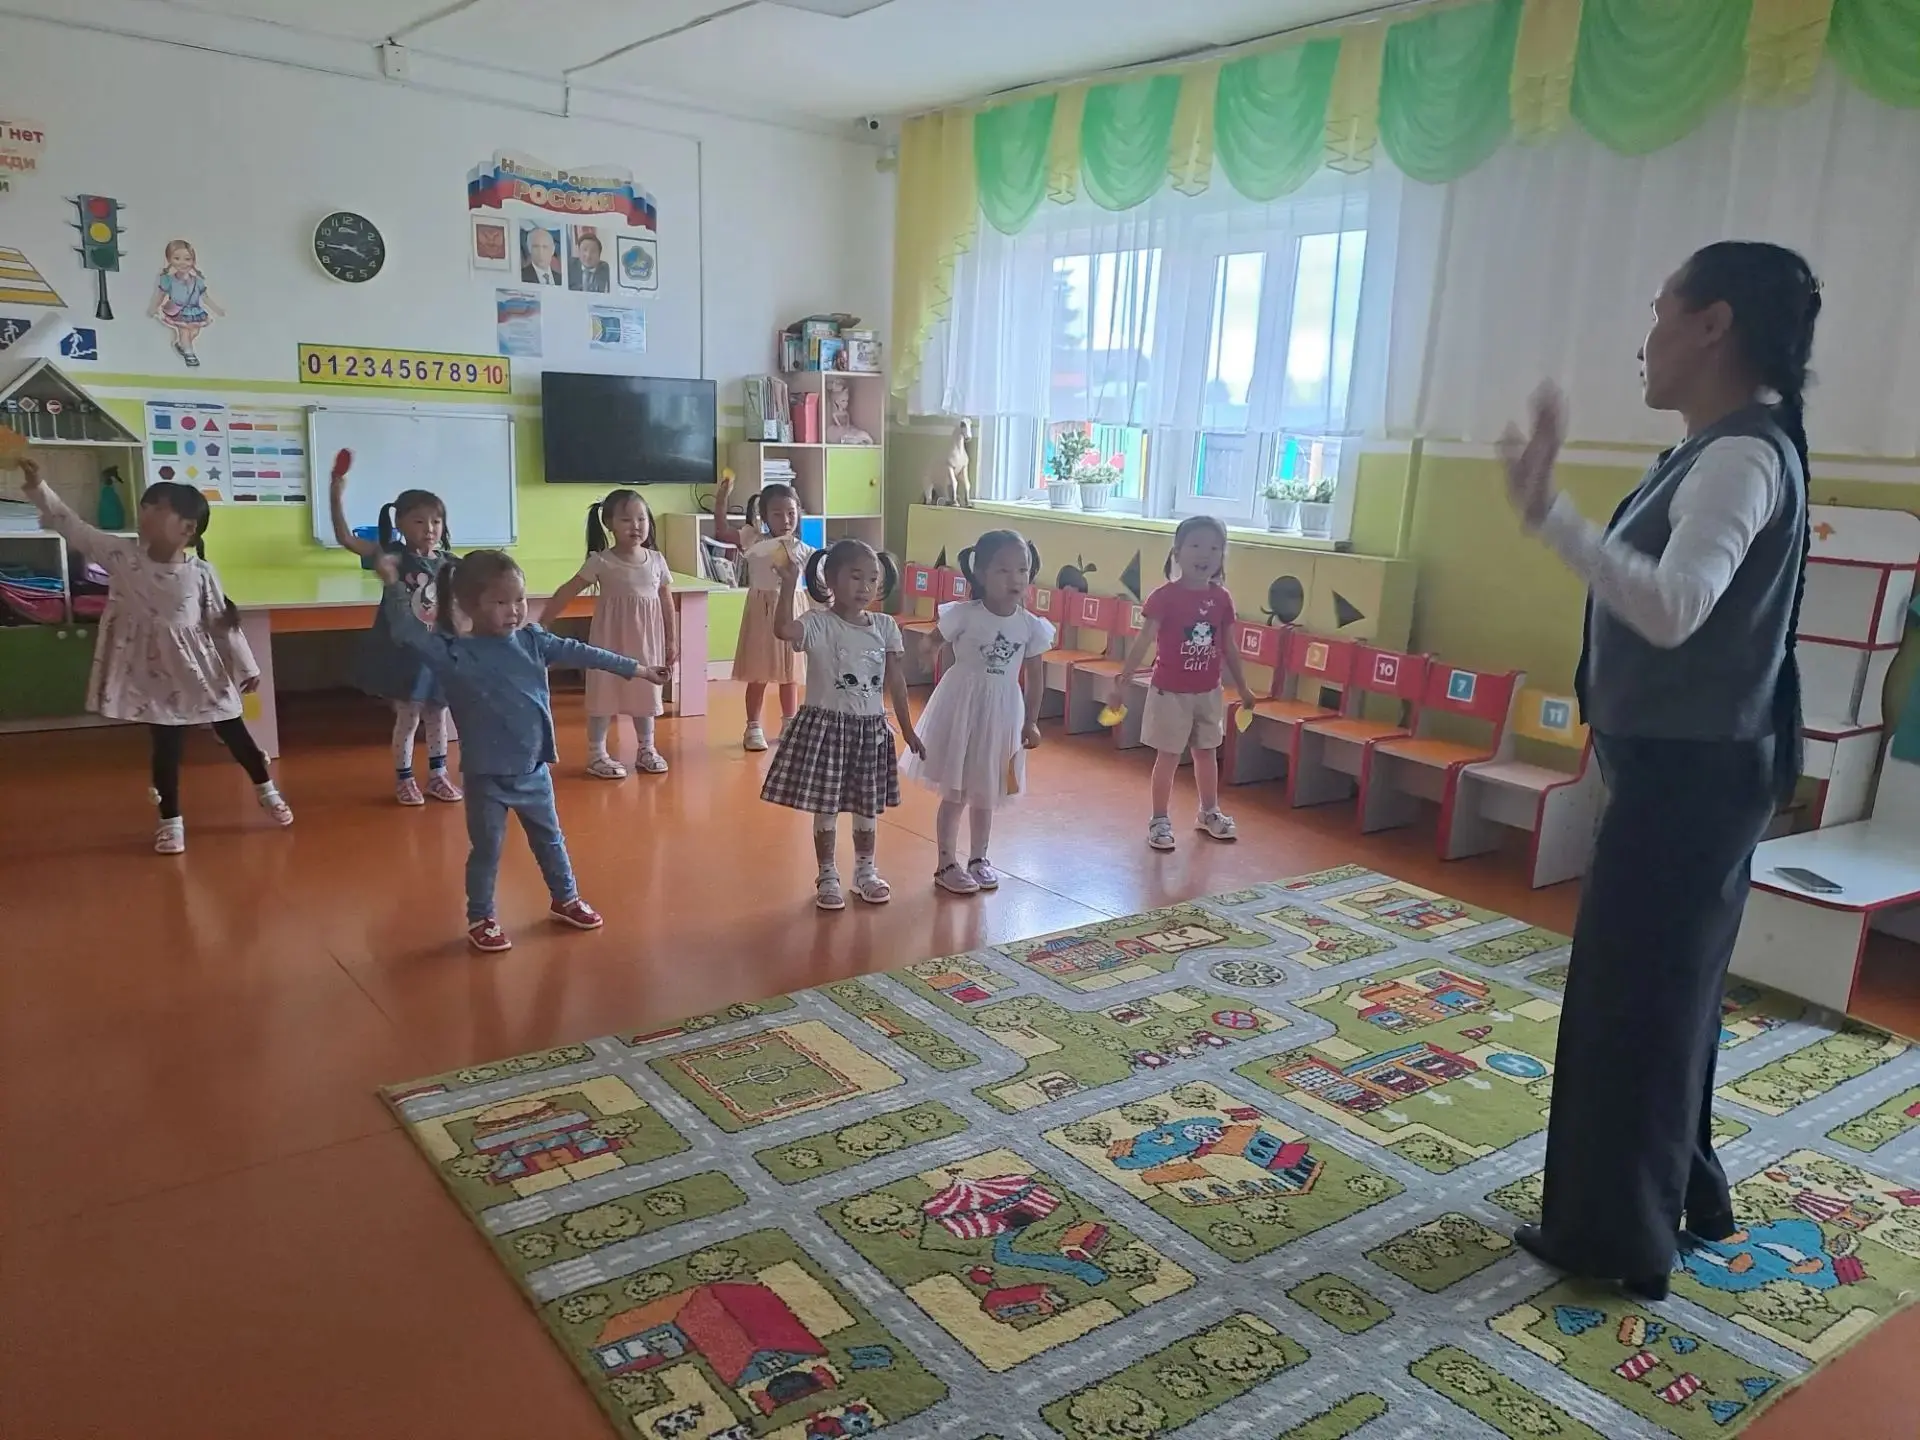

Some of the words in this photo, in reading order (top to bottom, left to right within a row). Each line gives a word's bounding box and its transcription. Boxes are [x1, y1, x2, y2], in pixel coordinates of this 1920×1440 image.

[9, 128, 43, 143] нет
[513, 180, 615, 211] РОССИЯ
[331, 218, 338, 227] 11
[343, 216, 353, 225] 12
[321, 228, 331, 236] 10
[367, 232, 376, 241] 2
[316, 240, 325, 249] 9
[373, 247, 380, 255] 3
[322, 255, 330, 263] 8
[368, 260, 376, 268] 4
[333, 266, 341, 274] 7
[359, 269, 367, 278] 5
[345, 271, 354, 279] 6
[308, 354, 321, 374] 0
[328, 355, 337, 375] 1
[345, 356, 358, 376] 2
[364, 357, 376, 377] 3
[381, 359, 393, 378] 4
[399, 360, 410, 379] 5
[416, 361, 427, 380] 6
[432, 361, 443, 380] 7
[450, 363, 461, 382] 8
[466, 364, 477, 383] 9
[483, 365, 503, 384] 10
[1246, 635, 1258, 648] 16
[1184, 656, 1210, 670] Girl
[1379, 663, 1394, 676] 10
[1457, 679, 1467, 692] 7
[1549, 708, 1563, 723] 11
